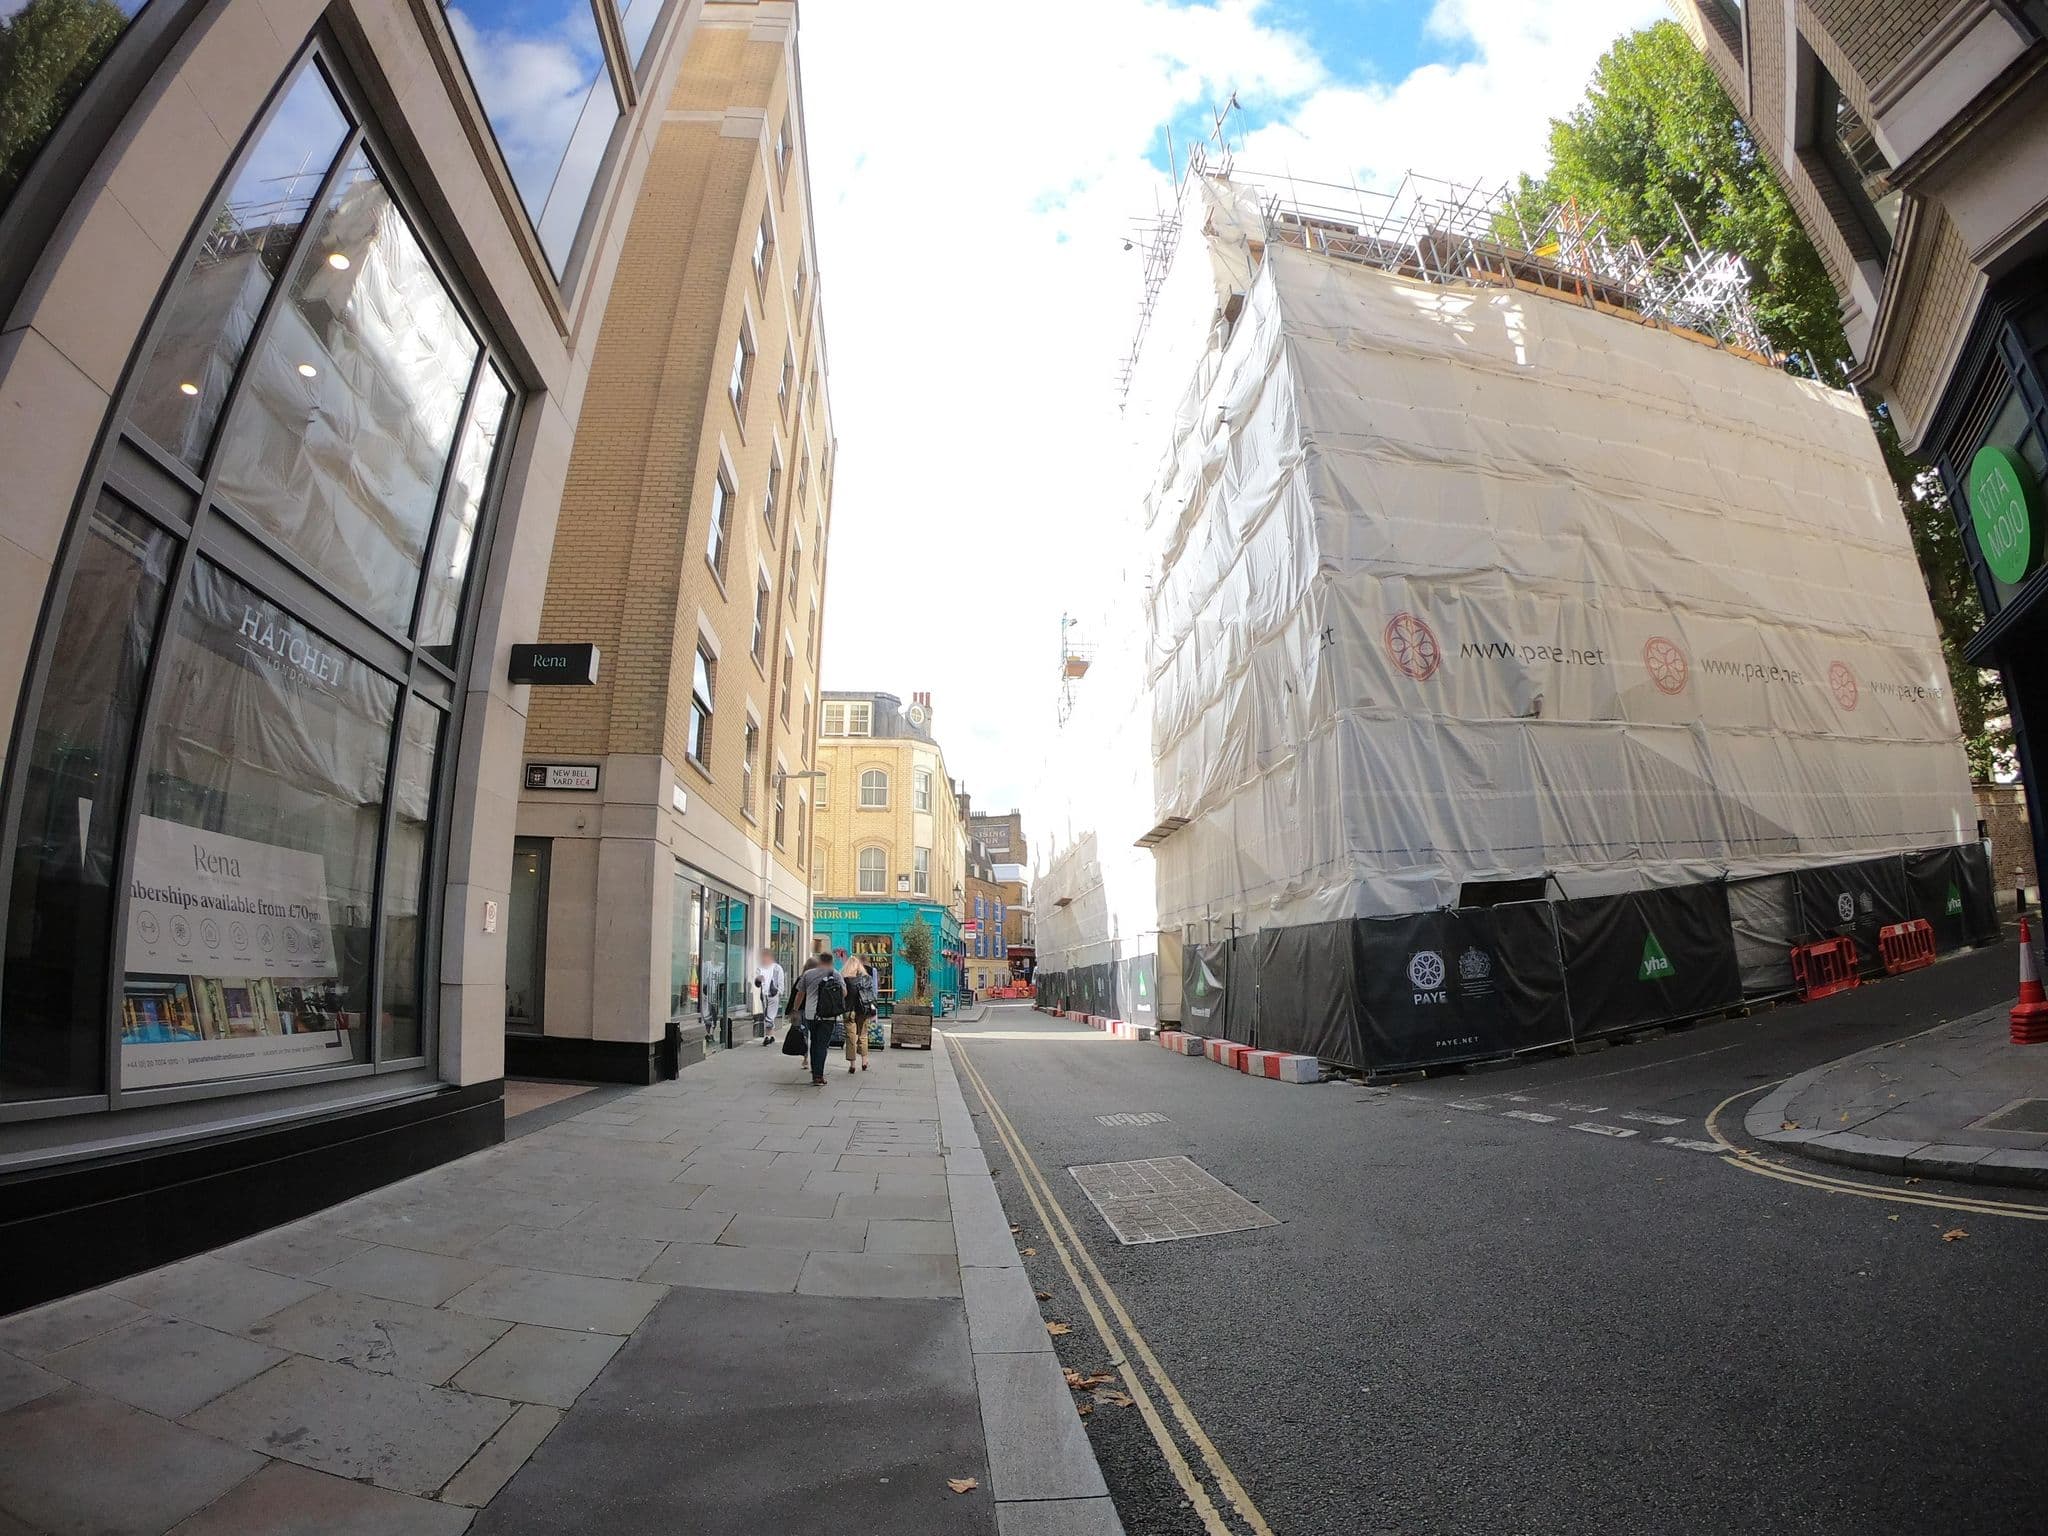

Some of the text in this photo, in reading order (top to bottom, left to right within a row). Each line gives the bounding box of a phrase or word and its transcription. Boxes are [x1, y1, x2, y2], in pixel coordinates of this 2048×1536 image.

[1977, 467, 2010, 519] VITA
[1987, 500, 2024, 560] MOJO
[238, 604, 344, 686] HATCHET
[533, 654, 567, 667] Rena
[552, 769, 589, 777] NEW BELL
[552, 777, 591, 786] YARD EC4
[193, 844, 241, 878] Rena
[200, 894, 256, 914] available
[257, 899, 286, 918] from
[1946, 897, 1962, 912] yha
[856, 942, 887, 954] BAR
[1643, 956, 1668, 976] yha
[1413, 991, 1448, 1005] PAYE
[1436, 1036, 1479, 1047] PAYE.NET
